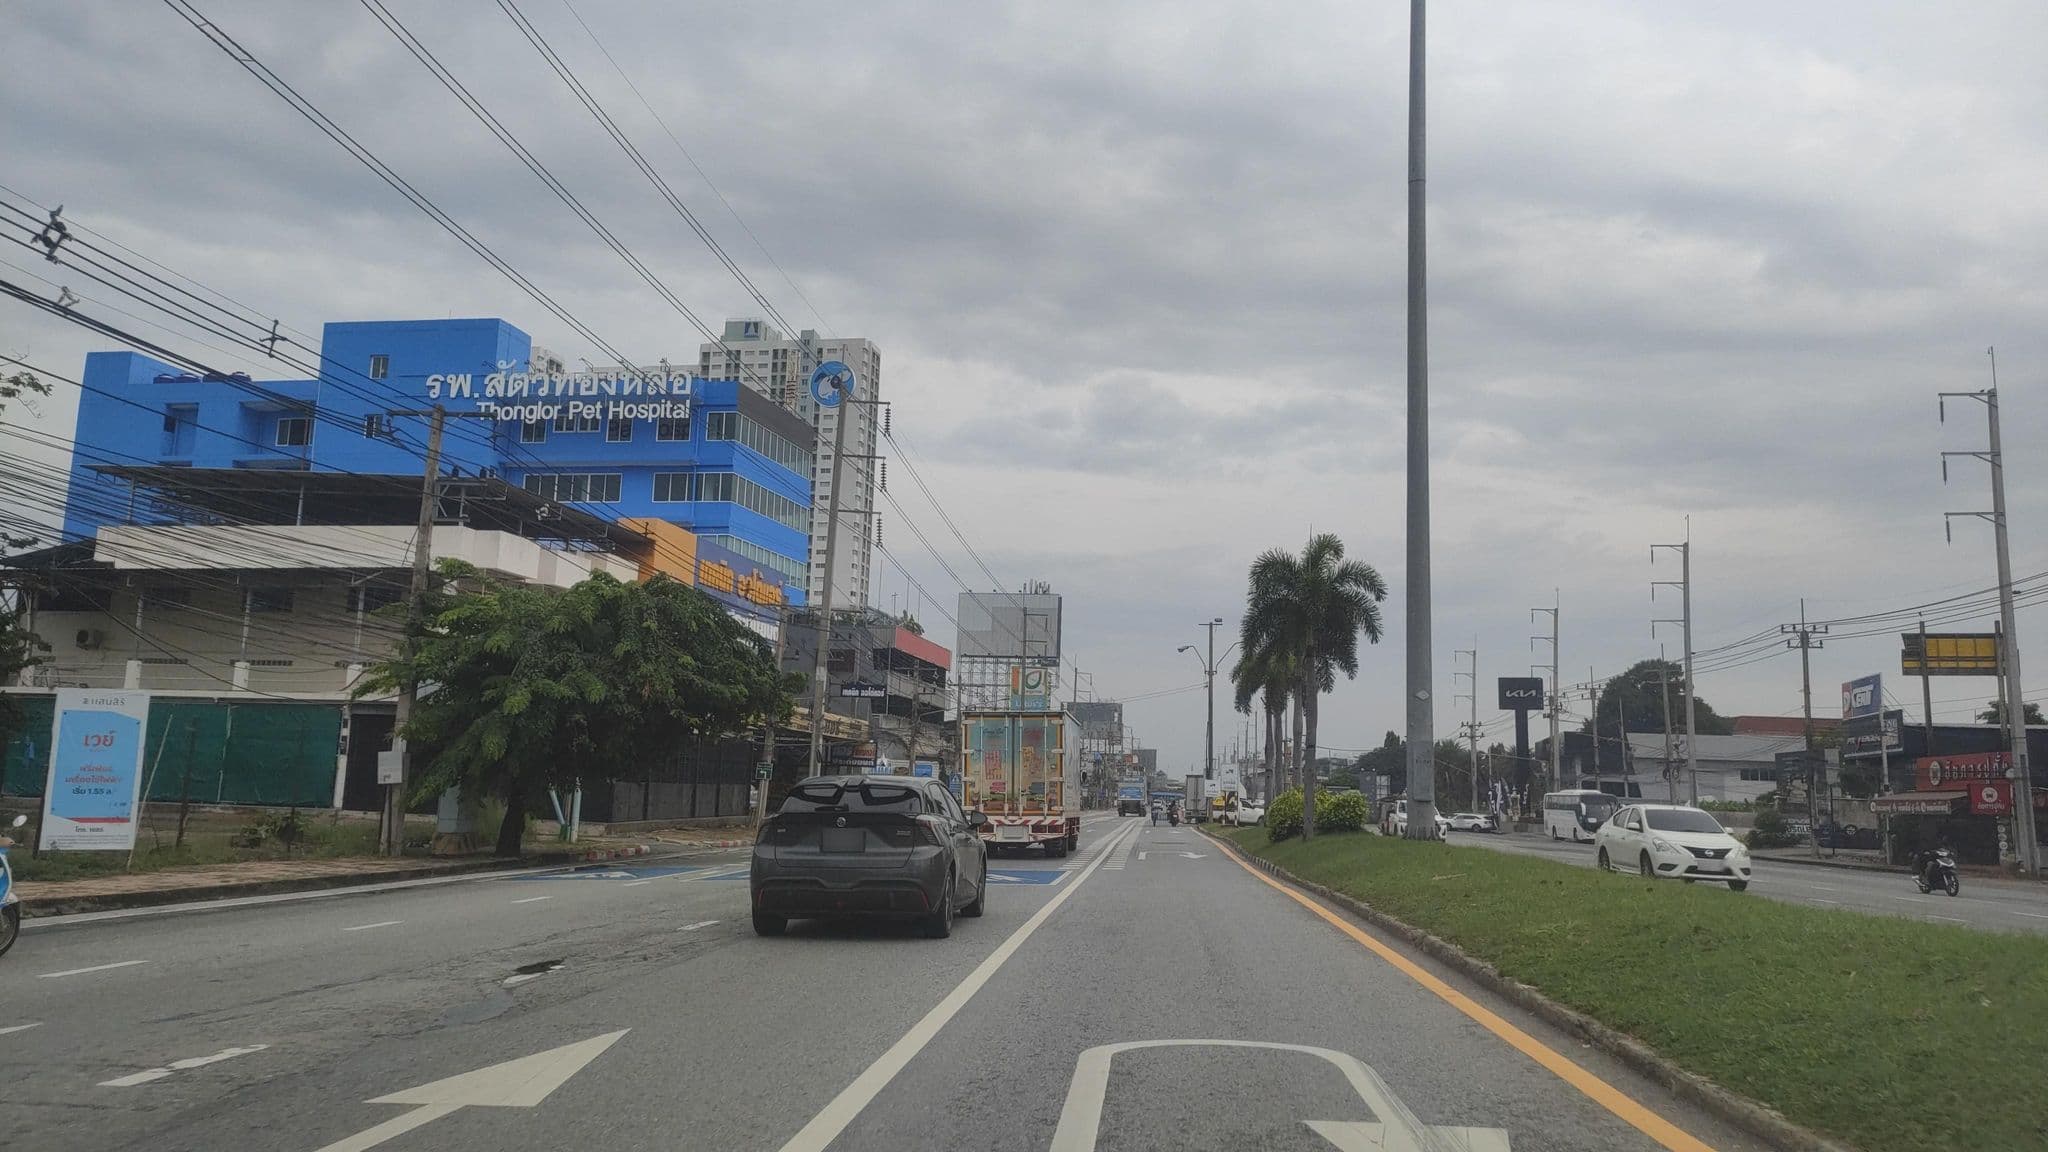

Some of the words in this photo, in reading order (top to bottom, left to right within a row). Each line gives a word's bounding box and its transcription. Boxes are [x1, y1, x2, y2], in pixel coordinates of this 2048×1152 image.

[476, 401, 561, 424] Thonglor
[569, 400, 603, 420] Pet
[608, 399, 691, 423] Hospital
